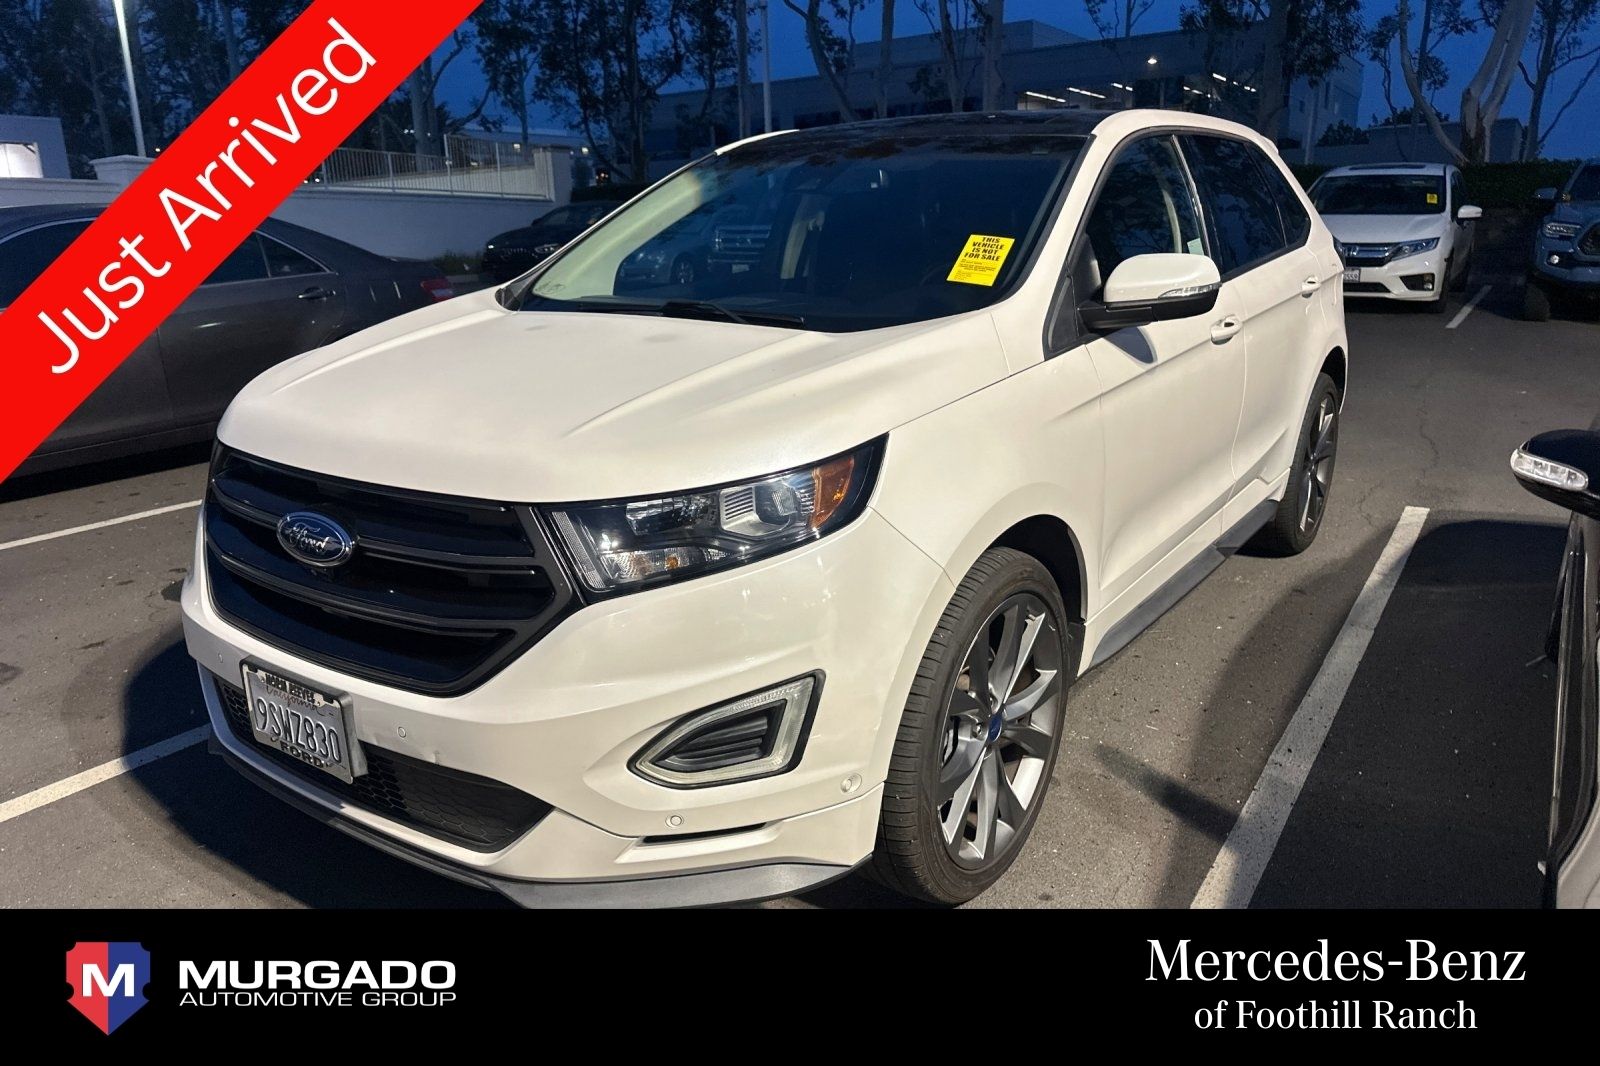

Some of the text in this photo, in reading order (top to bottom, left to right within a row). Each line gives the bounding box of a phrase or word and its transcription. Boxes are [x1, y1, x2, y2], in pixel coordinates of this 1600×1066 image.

[972, 241, 1005, 250] VEHICLE
[981, 254, 1001, 262] SALE
[283, 521, 331, 553] Ford
[256, 696, 343, 764] 9SWZ830
[280, 741, 325, 769] FORD
